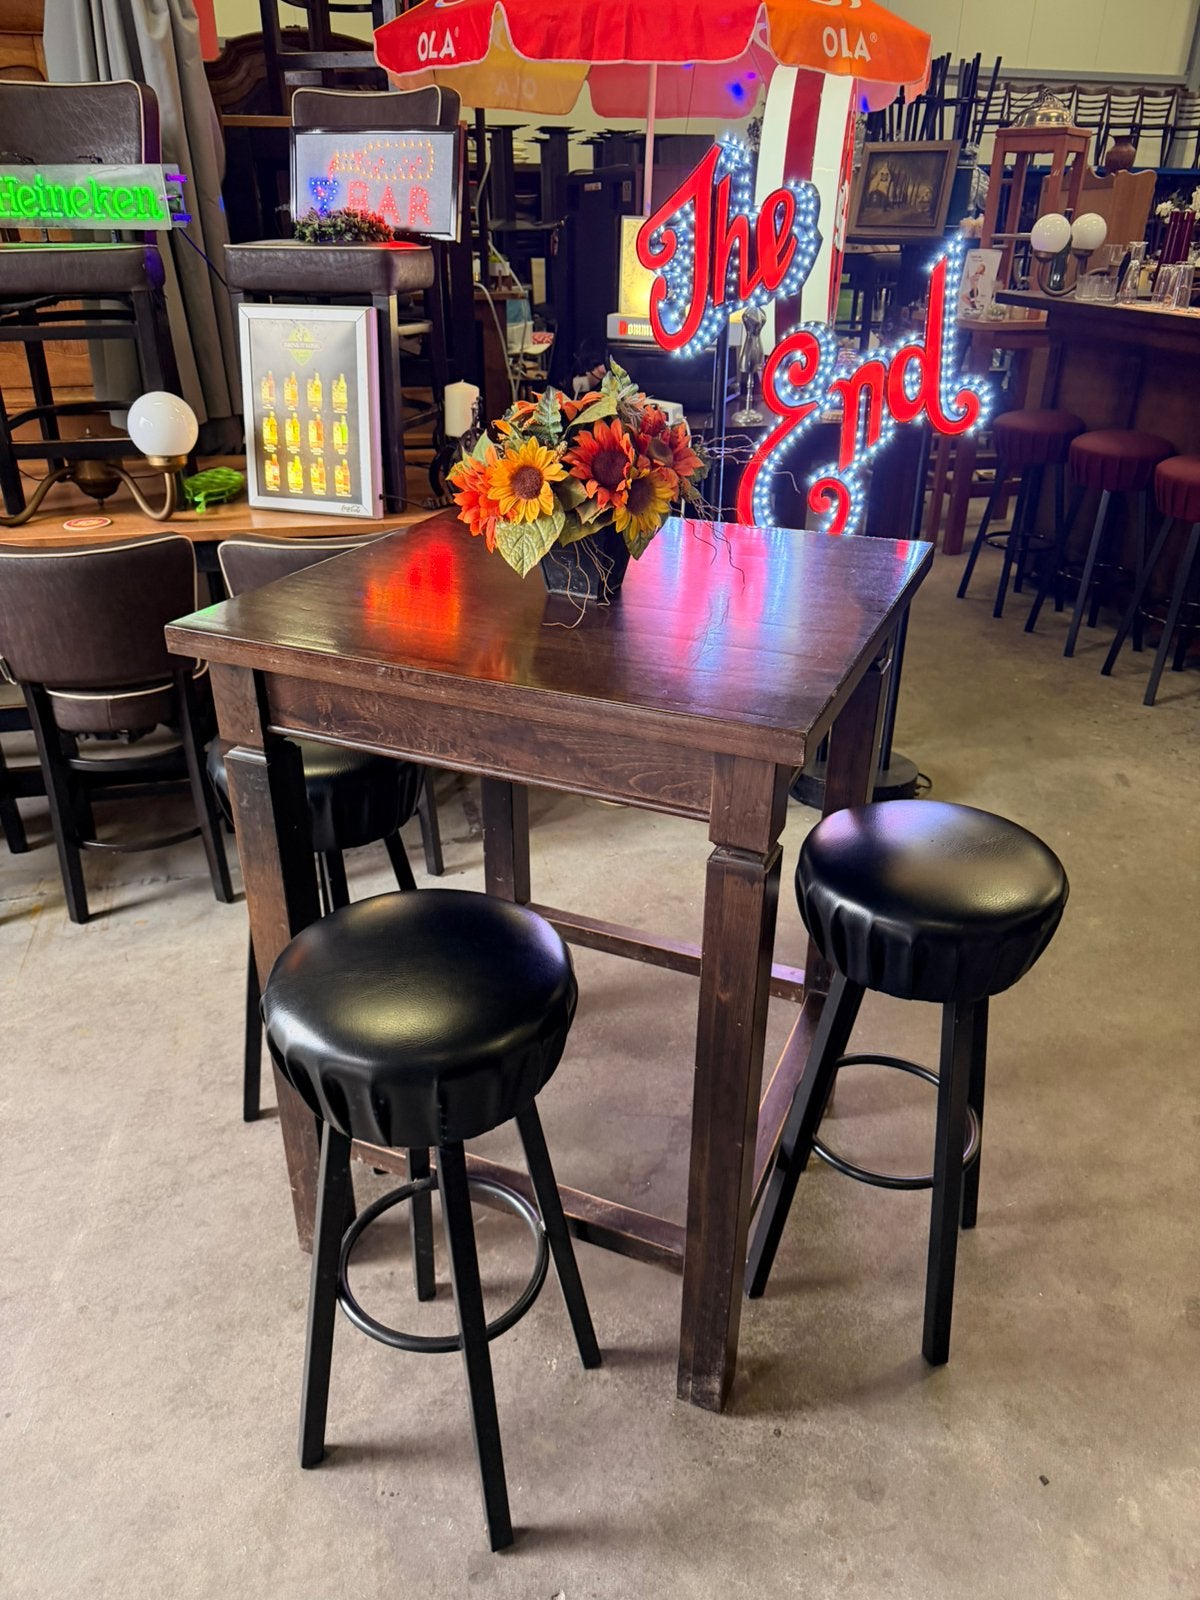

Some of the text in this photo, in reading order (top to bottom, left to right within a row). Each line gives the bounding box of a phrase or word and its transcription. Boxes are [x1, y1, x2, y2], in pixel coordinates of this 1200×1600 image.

[417, 30, 456, 61] OLA
[822, 26, 871, 62] OLA
[0, 173, 164, 220] Heineken
[349, 180, 431, 226] BAR
[637, 142, 799, 352] The
[737, 256, 982, 536] End
